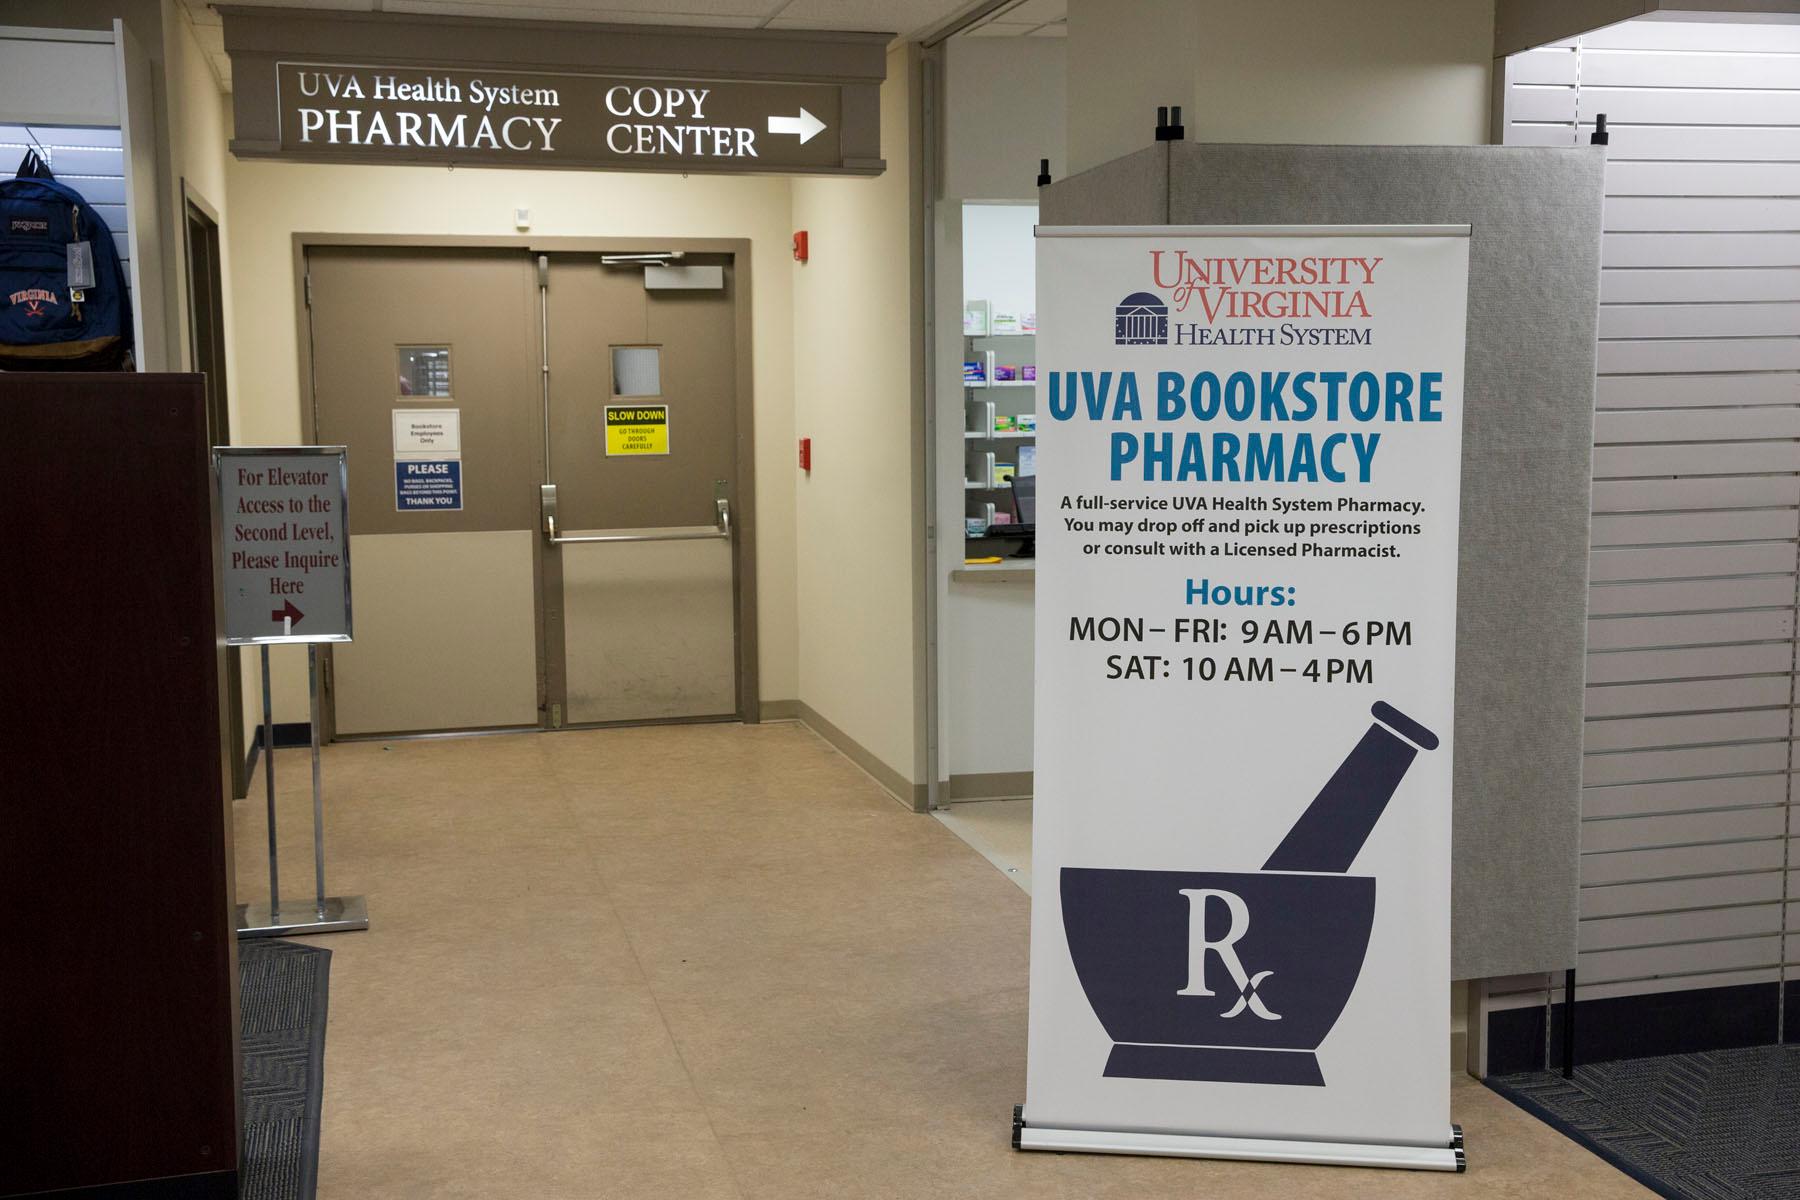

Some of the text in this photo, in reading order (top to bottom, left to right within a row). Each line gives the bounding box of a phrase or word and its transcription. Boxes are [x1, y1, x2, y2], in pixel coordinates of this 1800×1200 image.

[298, 72, 560, 112] UVA Health System
[605, 86, 711, 119] COPY
[298, 108, 563, 152] PHARMACY
[606, 123, 759, 158] CENTER
[1149, 250, 1384, 289] UNIVERSITY
[9, 288, 58, 305] VIRGINIA
[1173, 276, 1372, 325] of VIRGINIA
[1174, 323, 1373, 346] HEALTH SYSTEM
[1048, 371, 1443, 422] UVA BOOKSTORE
[608, 410, 665, 421] SLOW DOWN
[408, 464, 449, 474] PLEASE
[1110, 432, 1382, 483] PHARMACY
[237, 466, 328, 486] For Elevator
[236, 495, 331, 514] Access to the
[405, 496, 453, 505] THANK YOU
[1060, 495, 1426, 516] A full-service UVA Health System Pharmacy.
[234, 522, 334, 544] Second Level,
[1064, 517, 1422, 538] You may drop off and pick up prescriptions
[1083, 541, 1401, 558] or consult with a Licensed Pharmacist.
[232, 550, 339, 574] Please Inquire
[270, 577, 304, 595] Here
[1186, 578, 1296, 607] Hours:
[1174, 618, 1227, 643] FRI:
[1106, 655, 1170, 680] SAT:
[1183, 657, 1217, 681] 10
